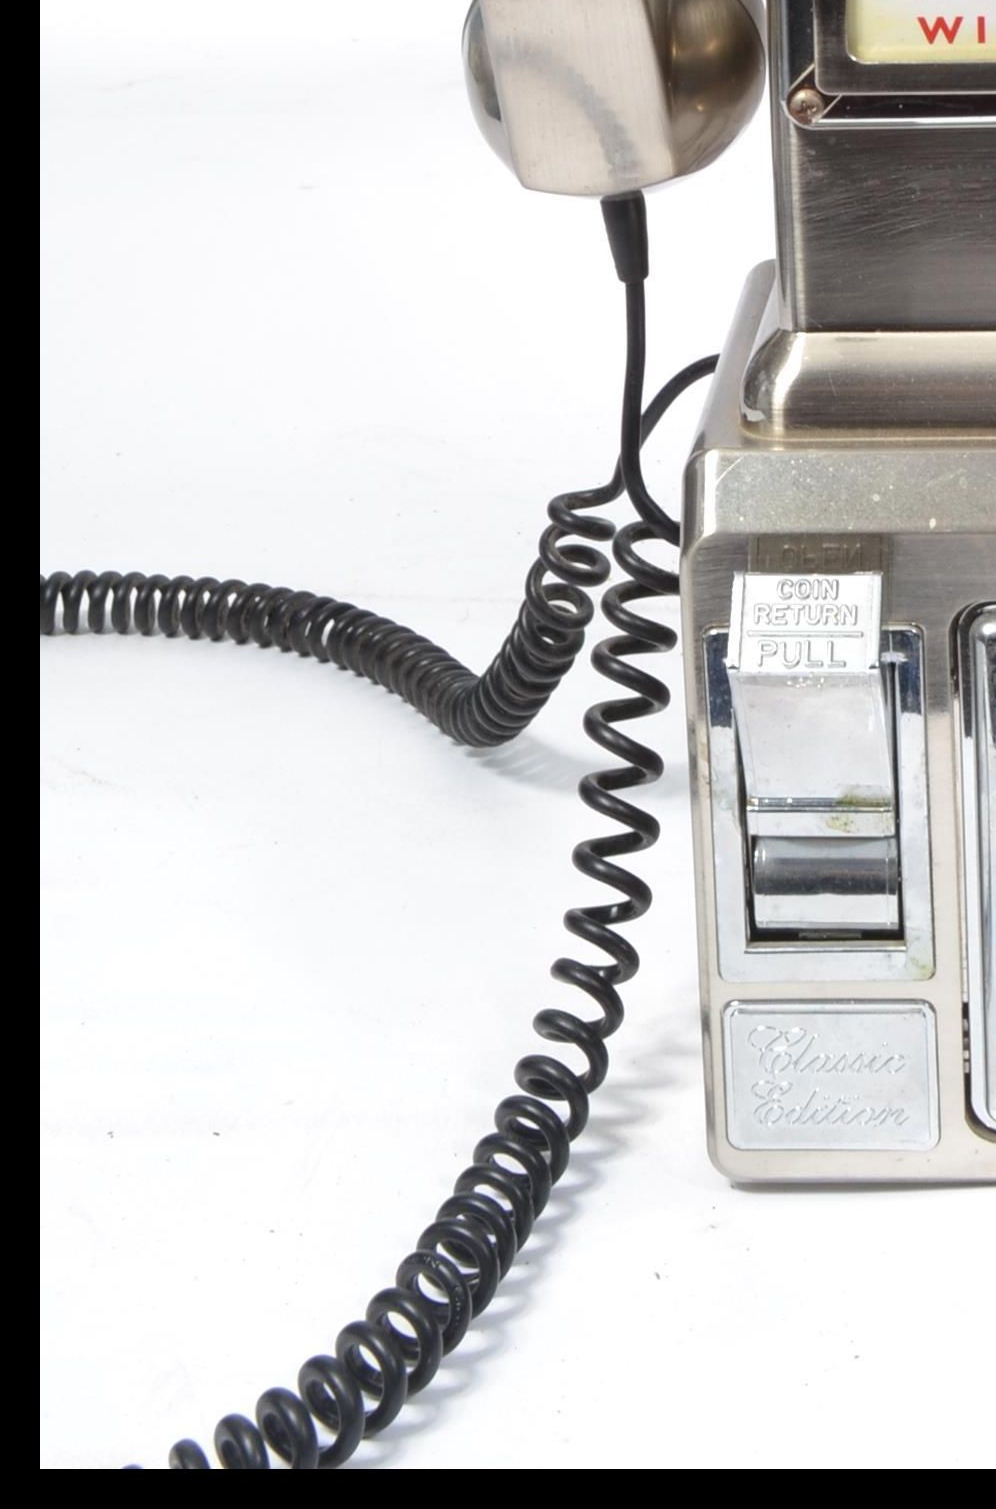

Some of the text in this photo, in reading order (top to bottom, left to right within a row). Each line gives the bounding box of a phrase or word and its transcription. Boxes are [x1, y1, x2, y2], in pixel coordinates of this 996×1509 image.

[776, 578, 840, 601] COIN
[753, 603, 858, 626] RETURN
[757, 640, 848, 669] PULL
[748, 1025, 906, 1079] Classic
[750, 1079, 910, 1126] Edition
